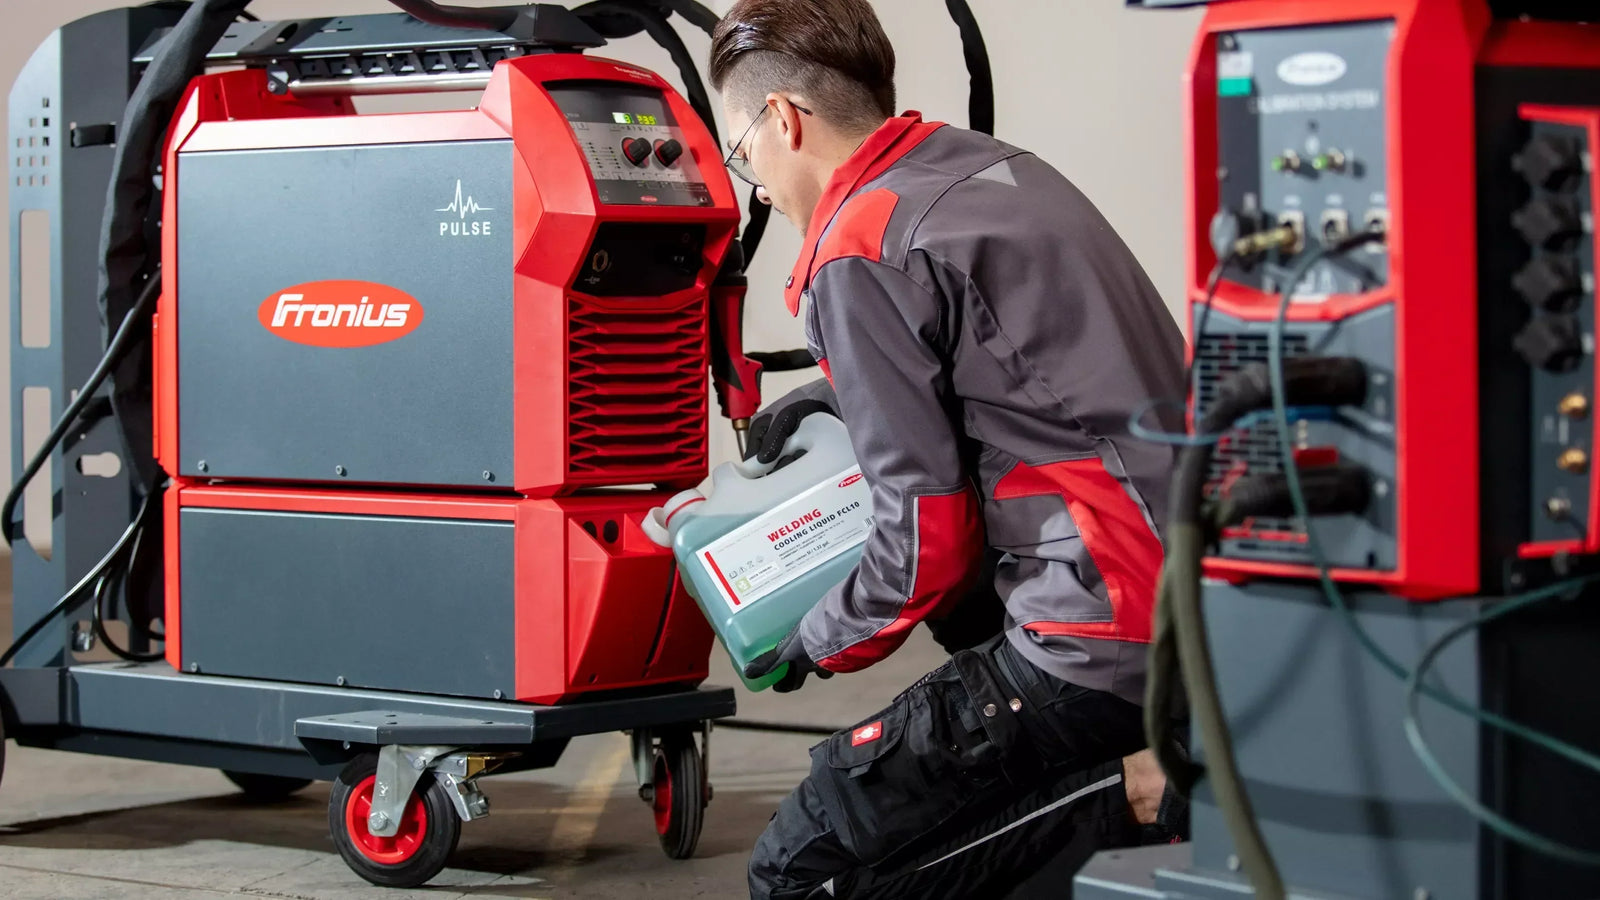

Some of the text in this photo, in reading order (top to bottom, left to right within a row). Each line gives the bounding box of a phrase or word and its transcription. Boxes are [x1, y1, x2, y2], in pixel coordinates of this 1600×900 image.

[440, 221, 491, 236] PULSE
[271, 293, 410, 328] Fronius
[767, 508, 822, 543] WELDING
[774, 529, 809, 551] COOLING
[809, 514, 836, 533] LIQUID
[837, 501, 860, 517] FCL10
